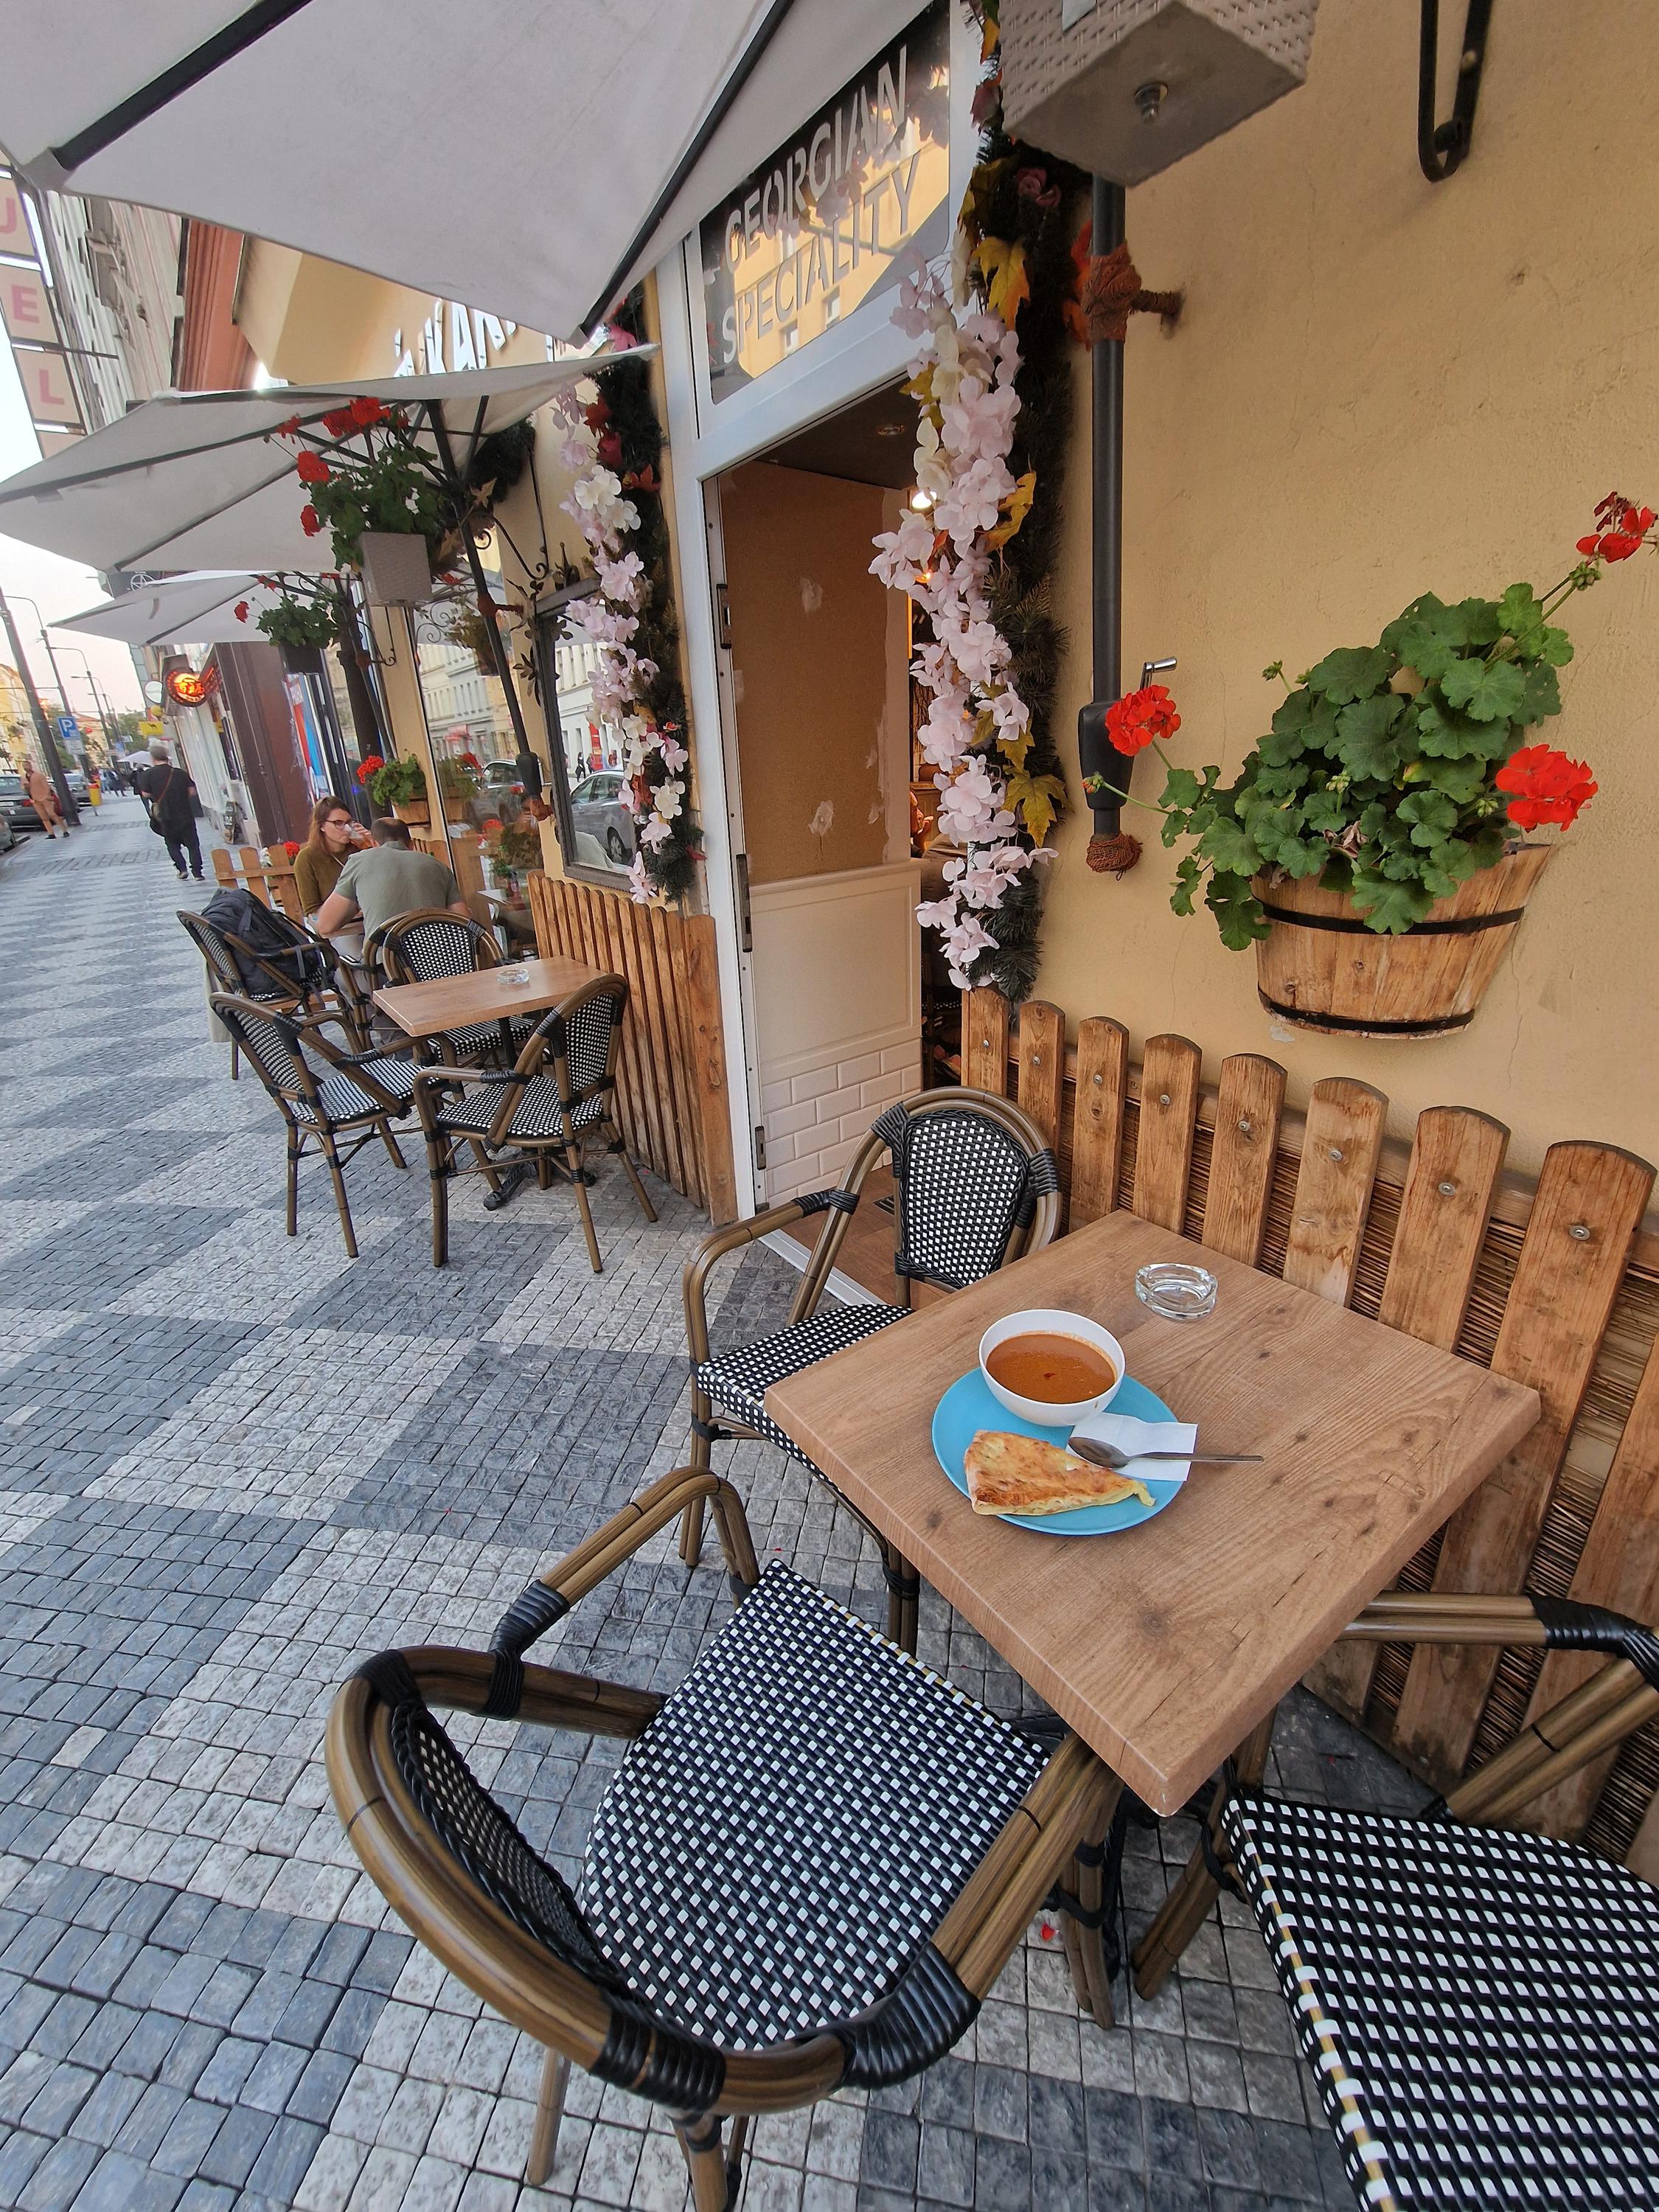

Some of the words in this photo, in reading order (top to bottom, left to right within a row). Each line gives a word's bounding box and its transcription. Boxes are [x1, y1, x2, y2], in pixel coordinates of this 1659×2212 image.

[722, 150, 921, 364] SPECIALITY
[725, 44, 907, 274] GEORGIAN
[61, 720, 73, 732] P
